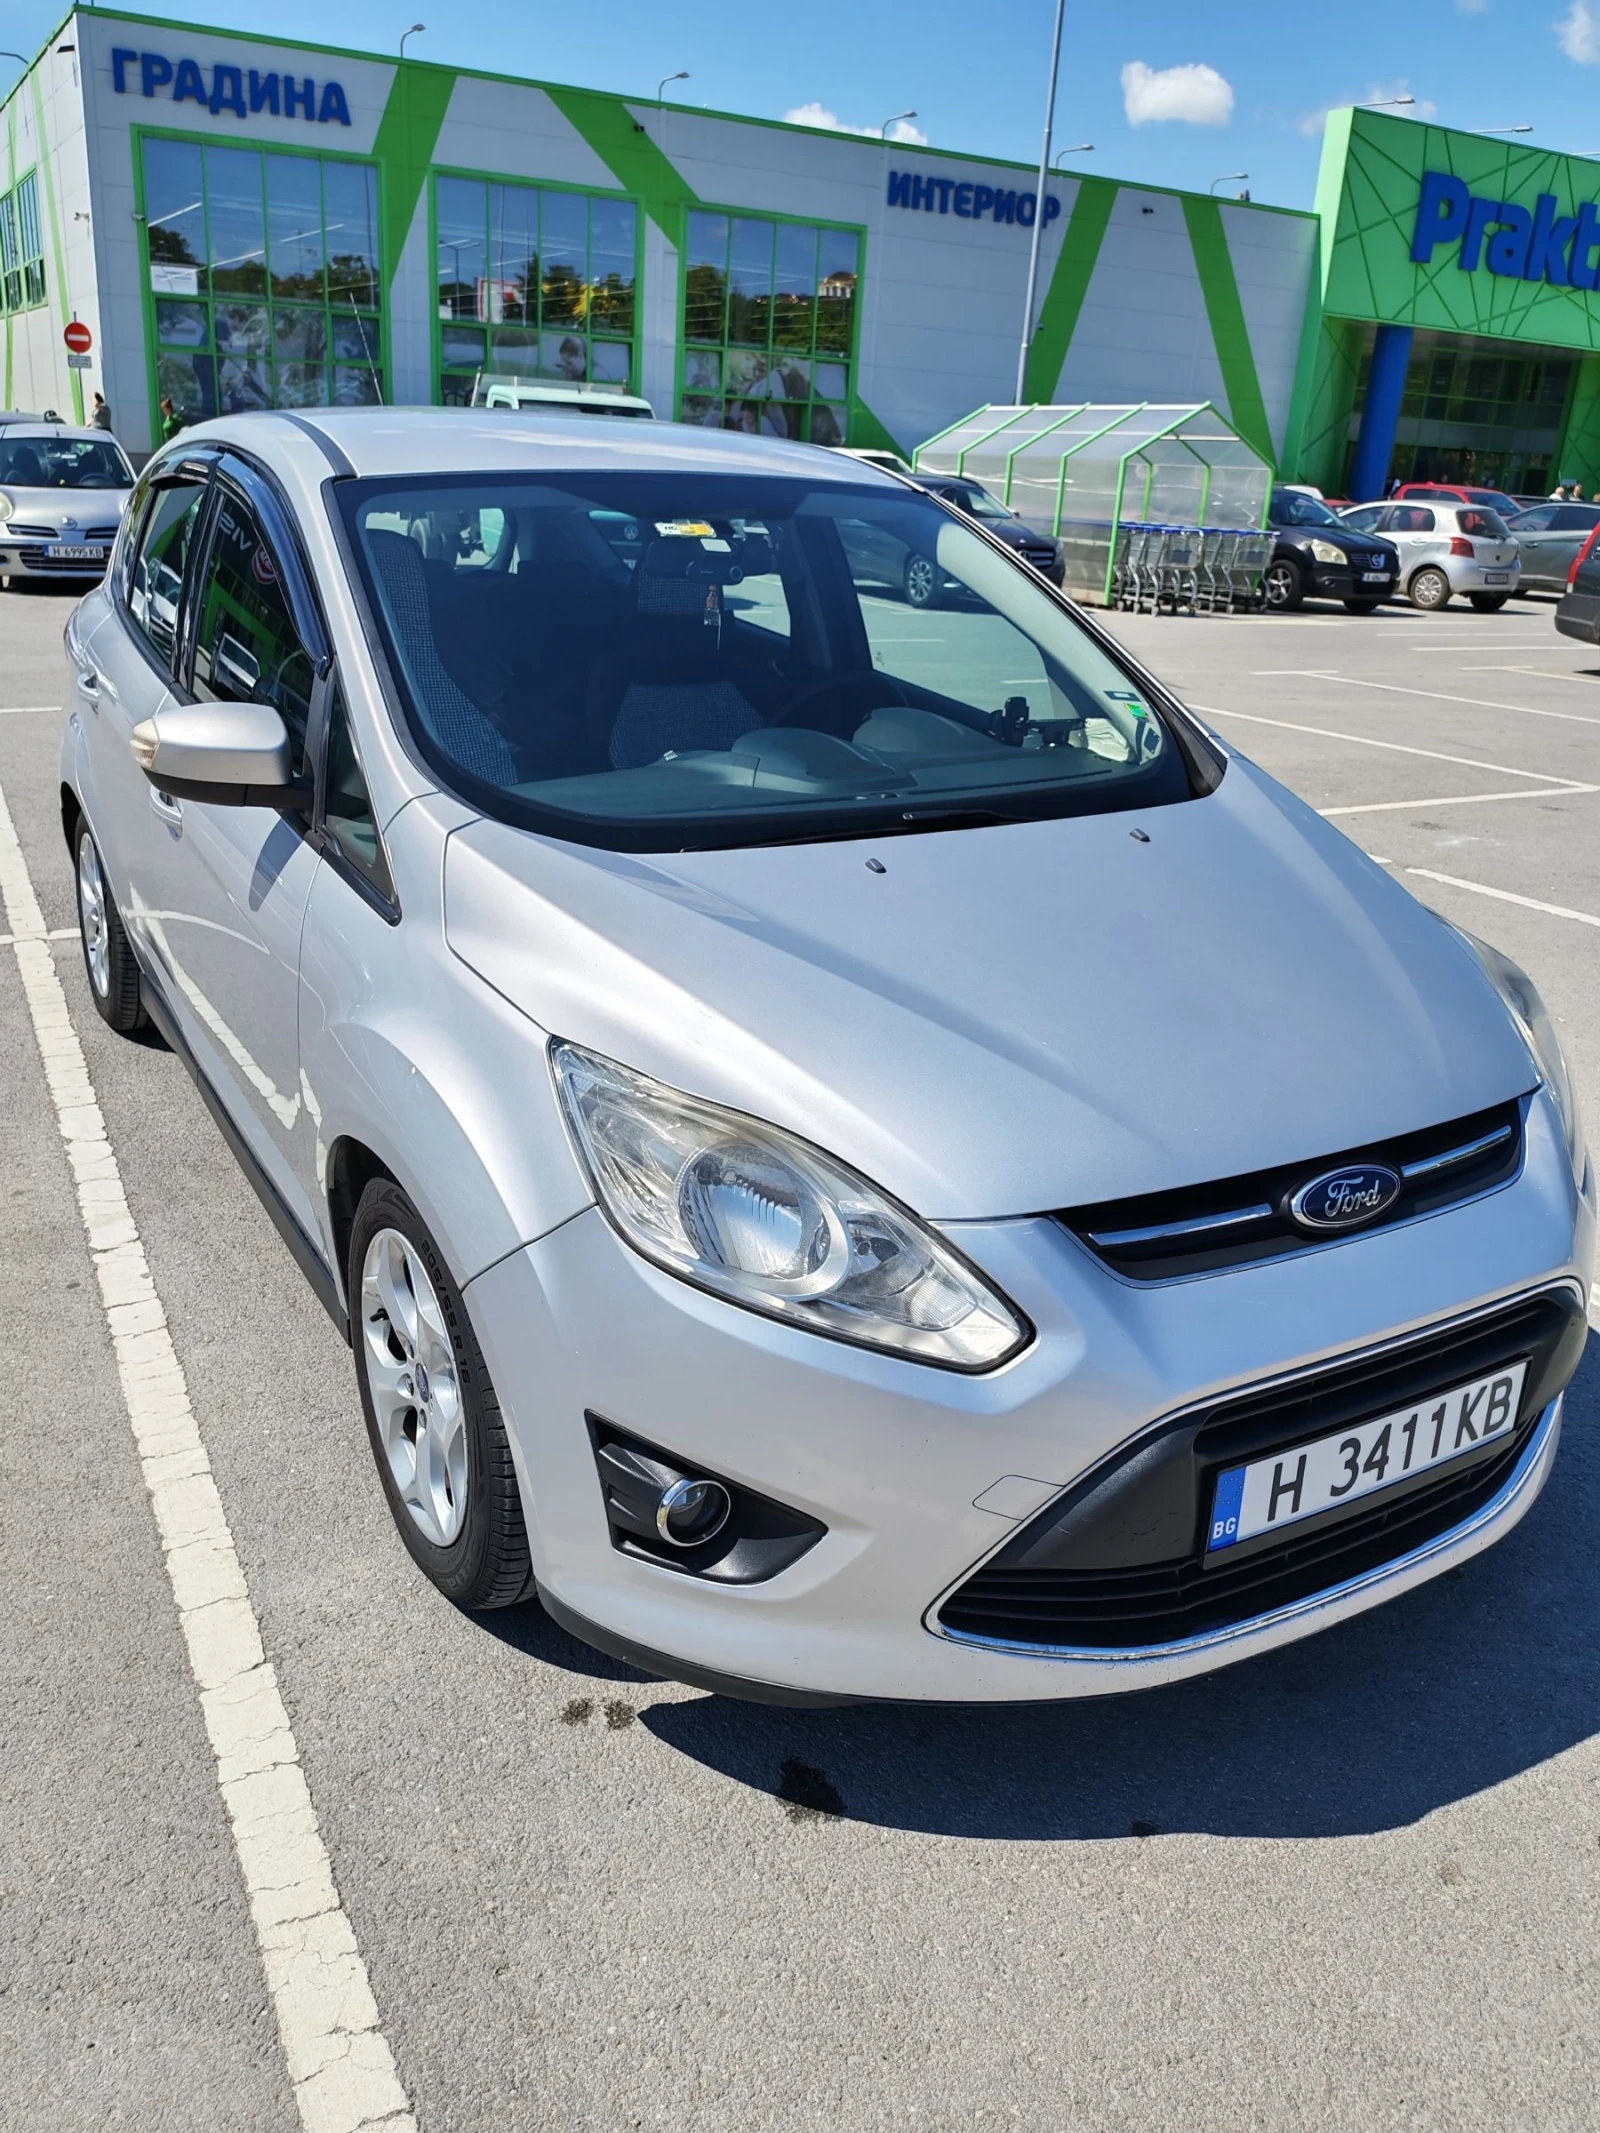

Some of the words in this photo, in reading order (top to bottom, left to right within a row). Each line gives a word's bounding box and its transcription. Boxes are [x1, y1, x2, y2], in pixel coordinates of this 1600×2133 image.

[112, 48, 352, 127] ГРАДИНА
[887, 171, 1061, 229] ИНТЕРИОР
[1409, 171, 1600, 292] Prakt
[1324, 1176, 1381, 1217] Ford
[420, 1239, 457, 1328] 205/55
[458, 1359, 471, 1385] 16
[1267, 1454, 1307, 1522] H
[1213, 1517, 1236, 1540] BG
